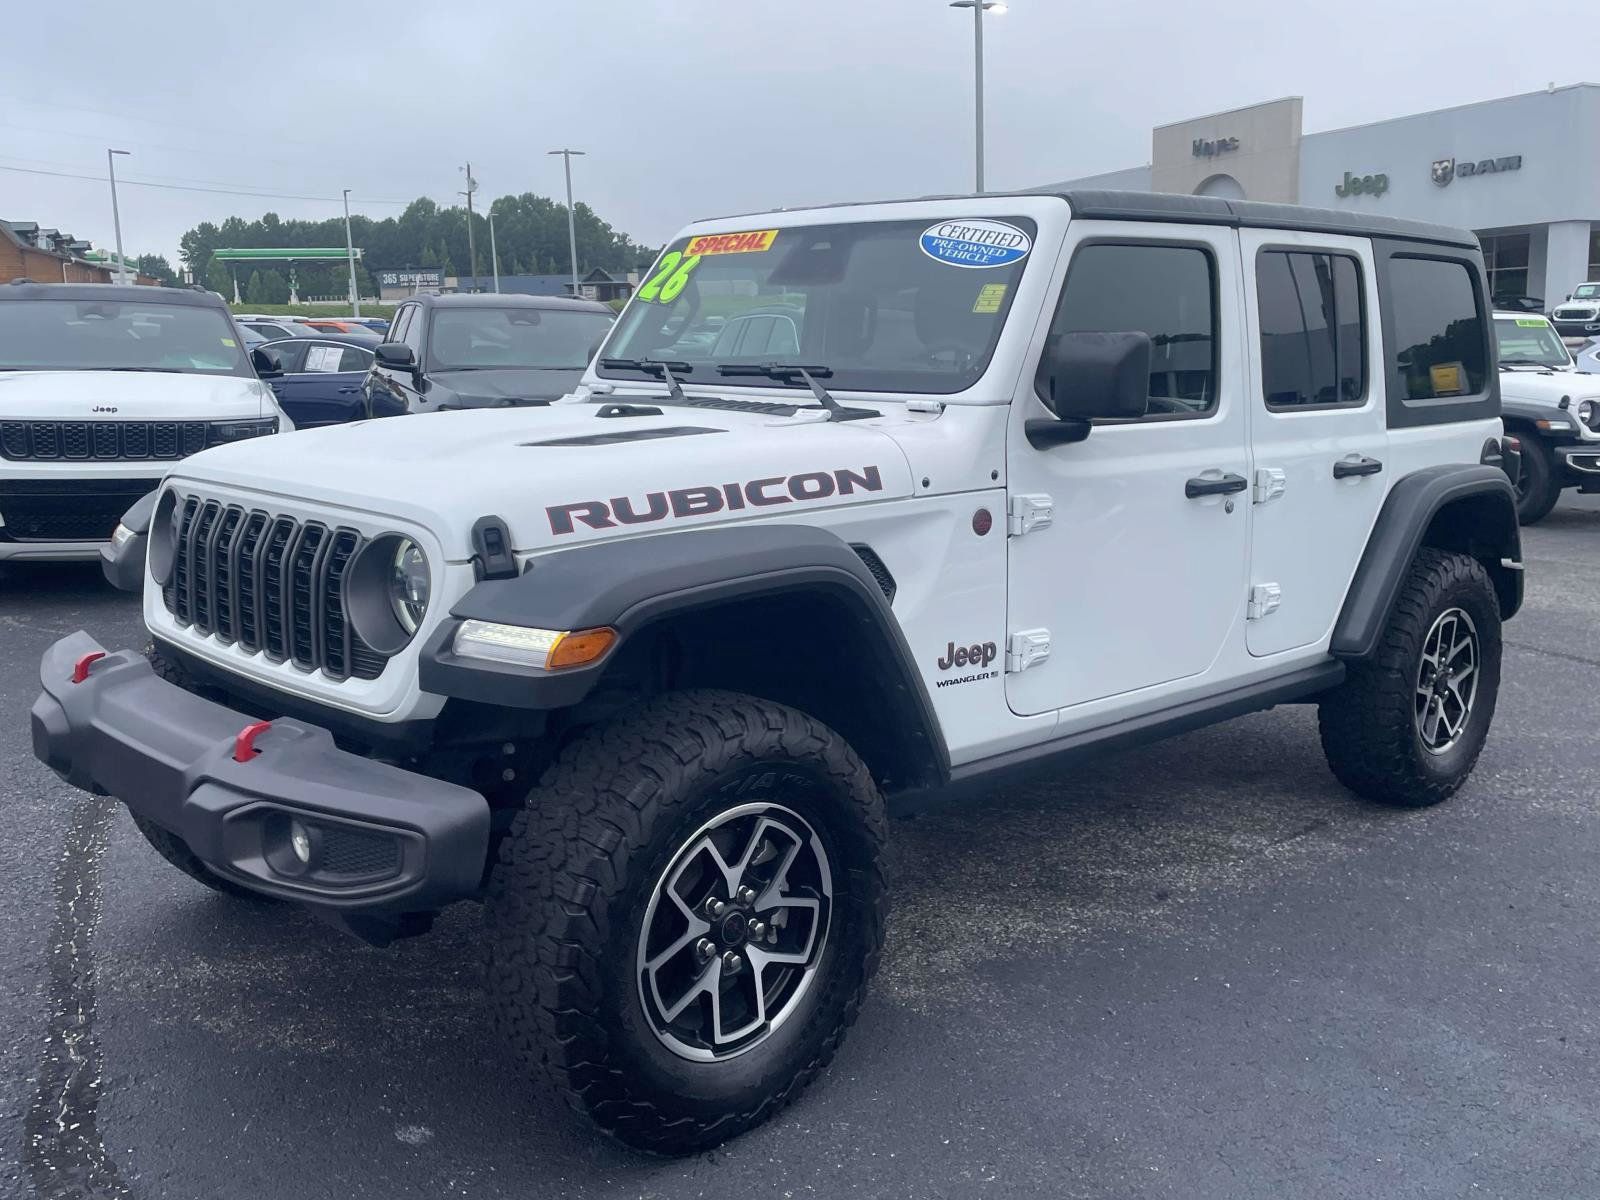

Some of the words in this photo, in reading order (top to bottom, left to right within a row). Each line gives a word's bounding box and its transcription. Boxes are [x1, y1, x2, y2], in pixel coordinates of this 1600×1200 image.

[1456, 155, 1522, 178] RAM
[1335, 171, 1390, 199] Jeep
[690, 232, 768, 254] SPECIAL
[938, 224, 1024, 248] CERTIFIED
[932, 238, 1007, 258] PRE-OWNED
[938, 248, 992, 264] VEHICLE
[382, 273, 398, 285] 365
[638, 251, 701, 304] 26
[92, 405, 118, 414] Jeep
[545, 465, 883, 536] RUBICON
[937, 641, 997, 670] Jeep
[936, 672, 989, 688] WRANGLER
